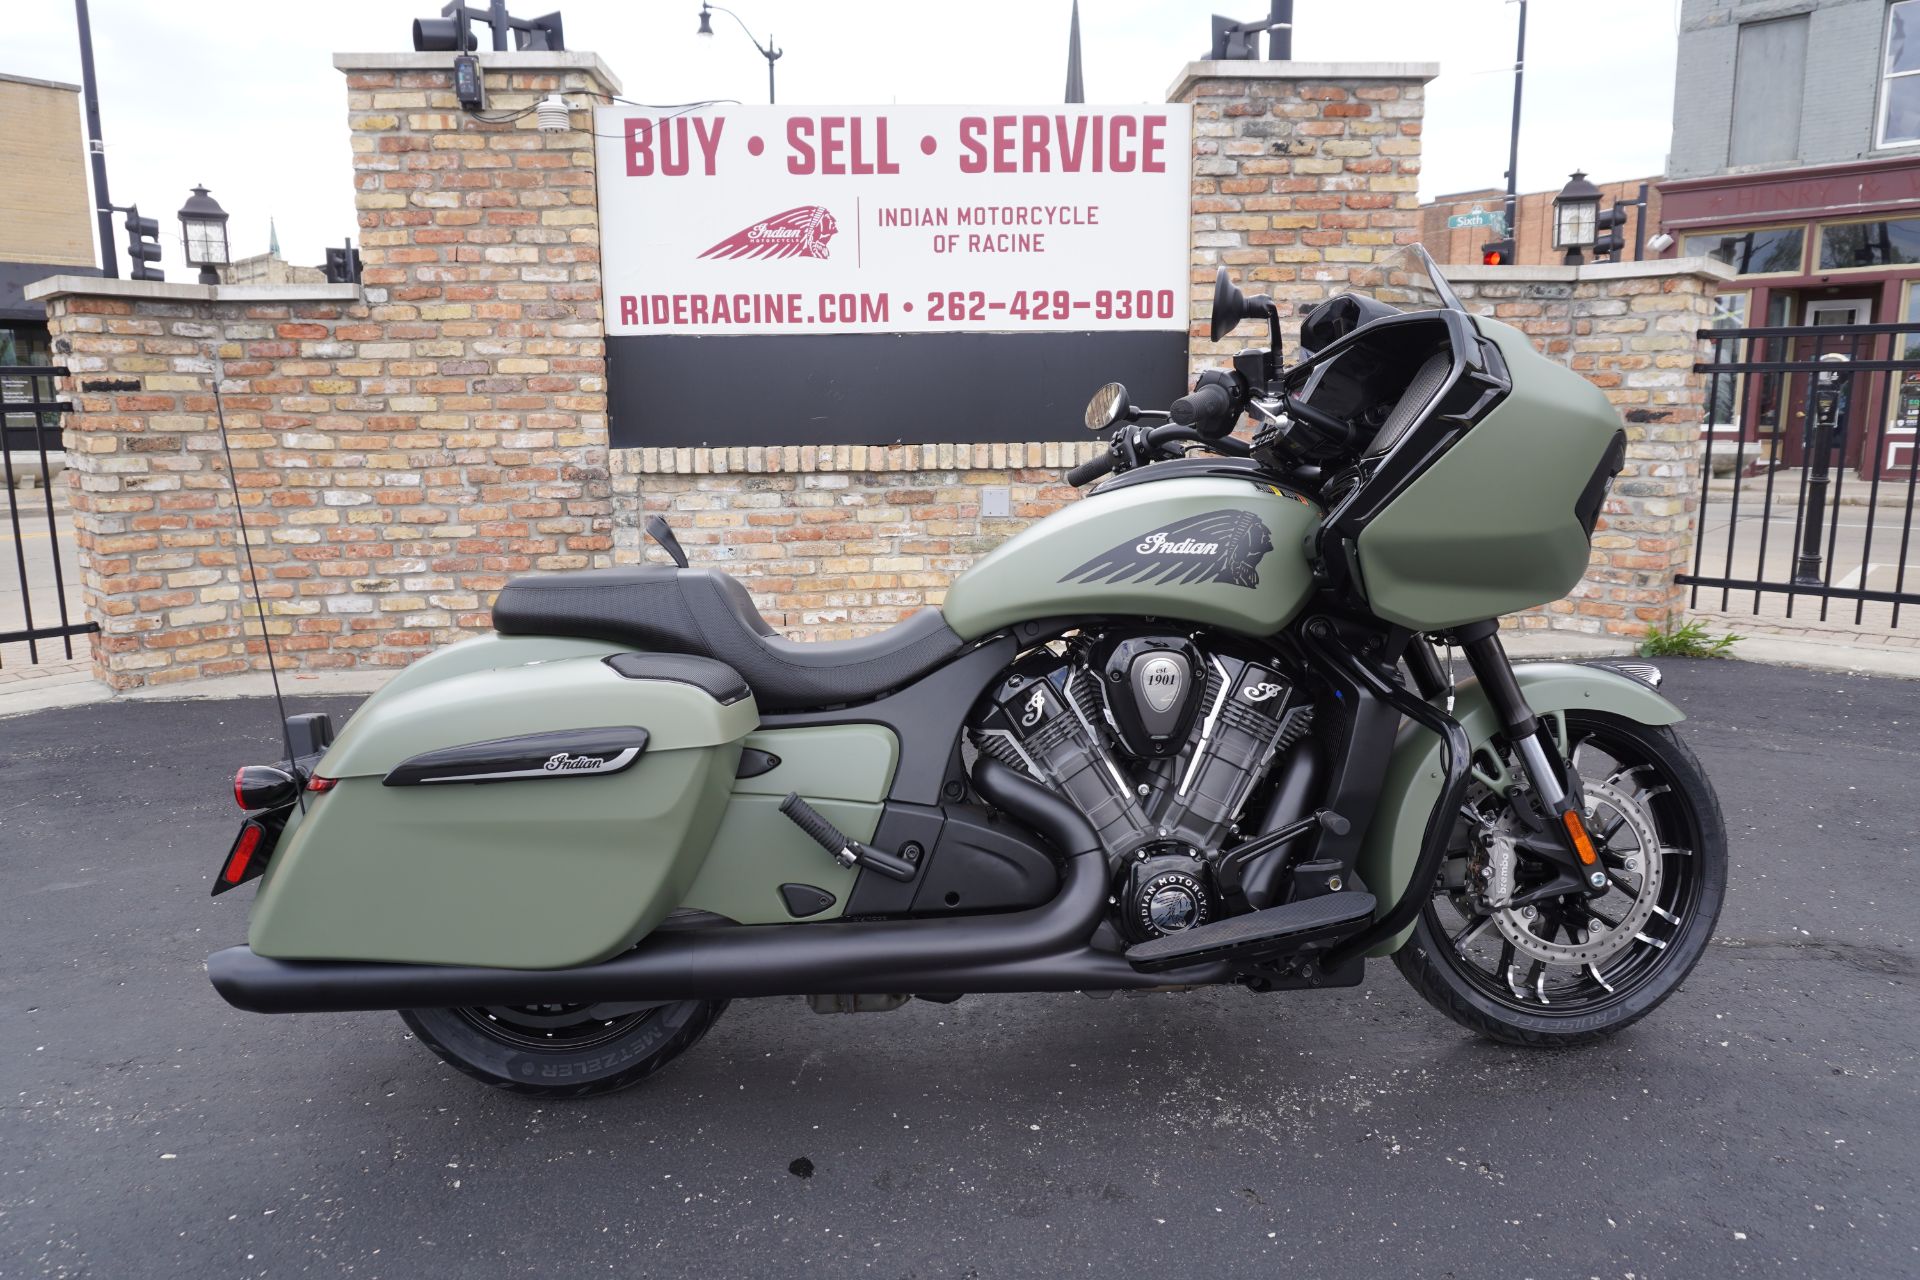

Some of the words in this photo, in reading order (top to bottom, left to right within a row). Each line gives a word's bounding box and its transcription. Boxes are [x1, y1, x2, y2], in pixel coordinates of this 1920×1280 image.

[624, 116, 725, 177] BUY
[786, 116, 900, 176] SELL
[959, 115, 1167, 174] SERVICE
[878, 207, 949, 227] INDIAN
[957, 205, 1100, 226] MOTORCYCLE
[1457, 214, 1483, 226] Sixth
[747, 222, 801, 239] Indian
[933, 235, 960, 254] OF
[968, 233, 1046, 253] RACINE
[619, 292, 890, 326] RIDERACINE.COM
[927, 289, 1175, 322] 262-429-9300
[1135, 532, 1219, 556] Indian
[1148, 674, 1175, 686] 1901
[544, 753, 604, 771] Indian
[1498, 853, 1509, 894] brembo
[1141, 885, 1157, 931] INDIAN
[1506, 1007, 1621, 1031] CRUISETEC
[541, 1027, 663, 1077] METZELER
